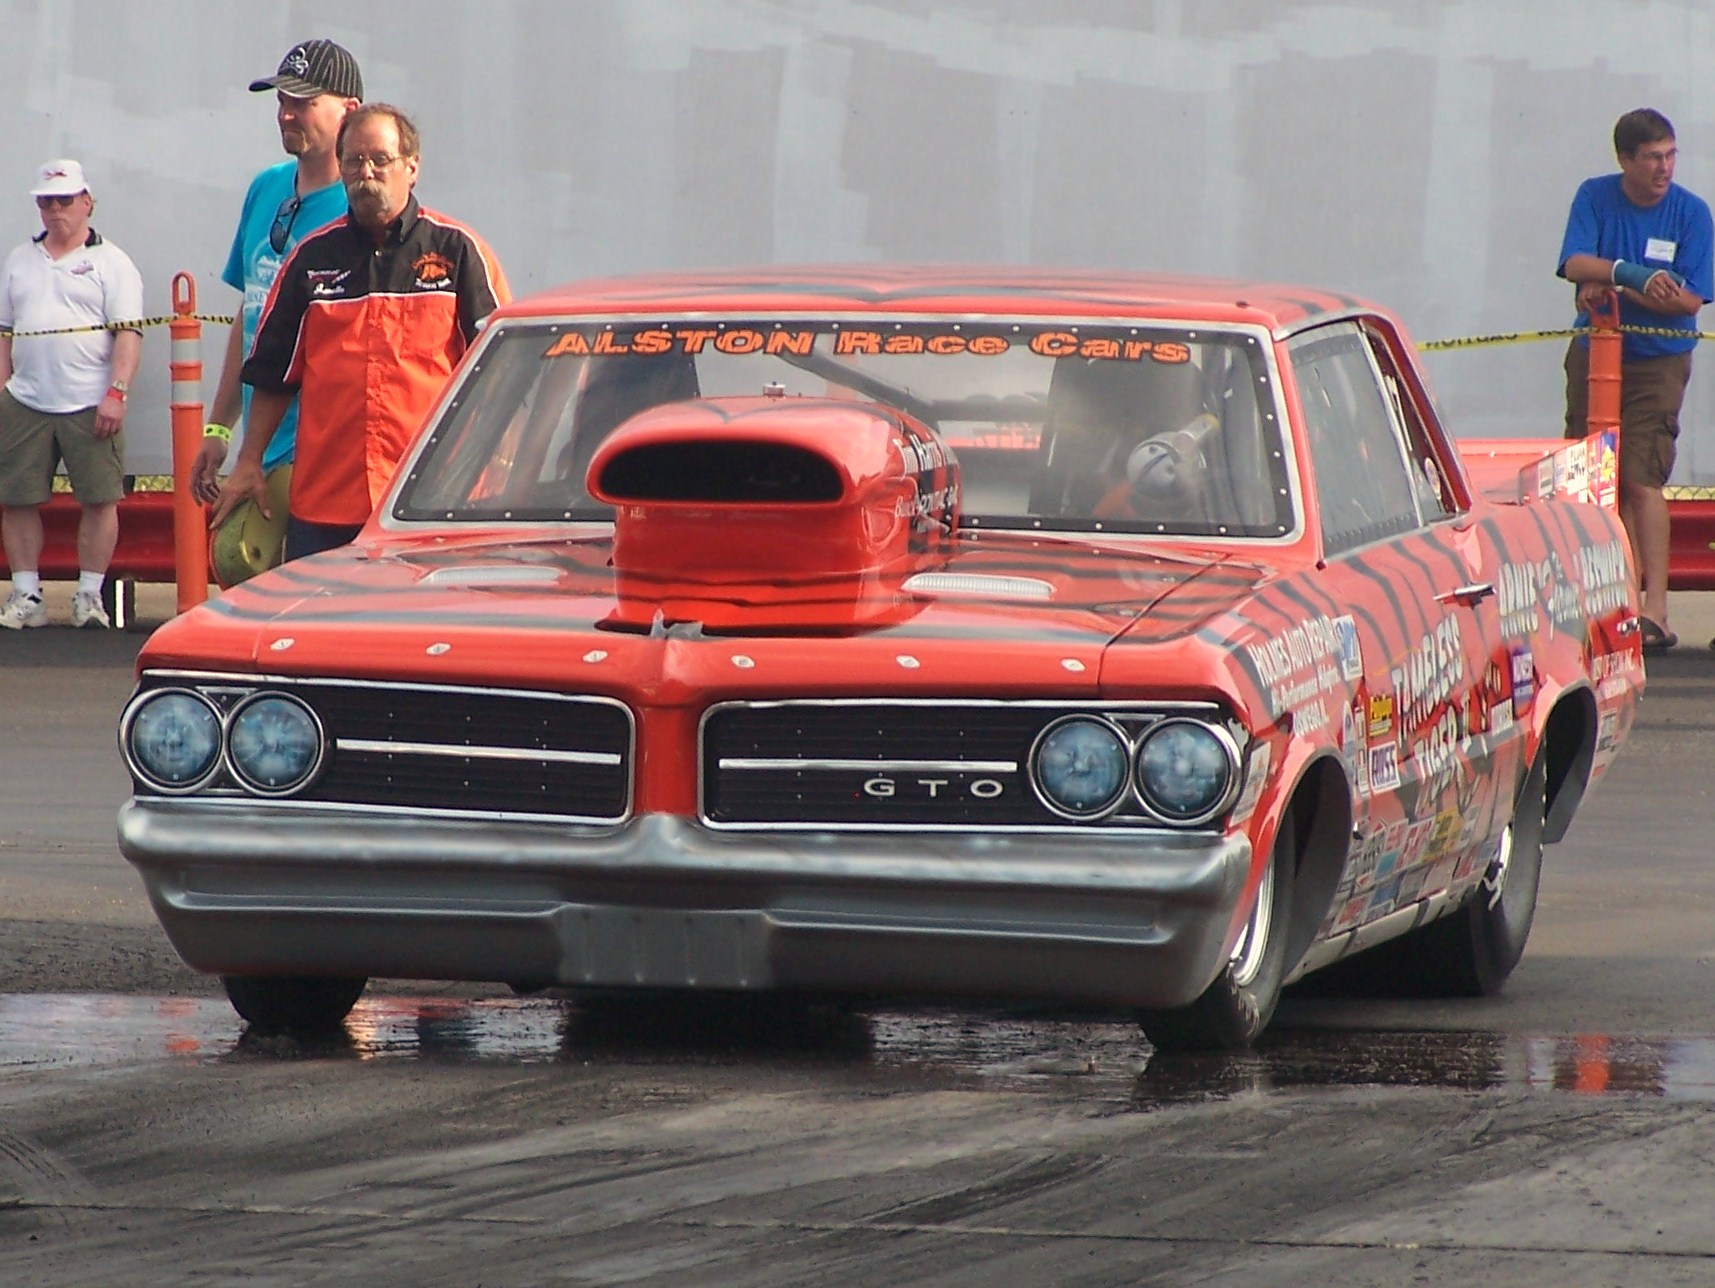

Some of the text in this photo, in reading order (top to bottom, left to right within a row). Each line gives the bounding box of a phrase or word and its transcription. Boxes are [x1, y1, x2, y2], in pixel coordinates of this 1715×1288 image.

[546, 330, 1191, 363] ALSTON Race Cars
[863, 778, 1003, 798] GTO
